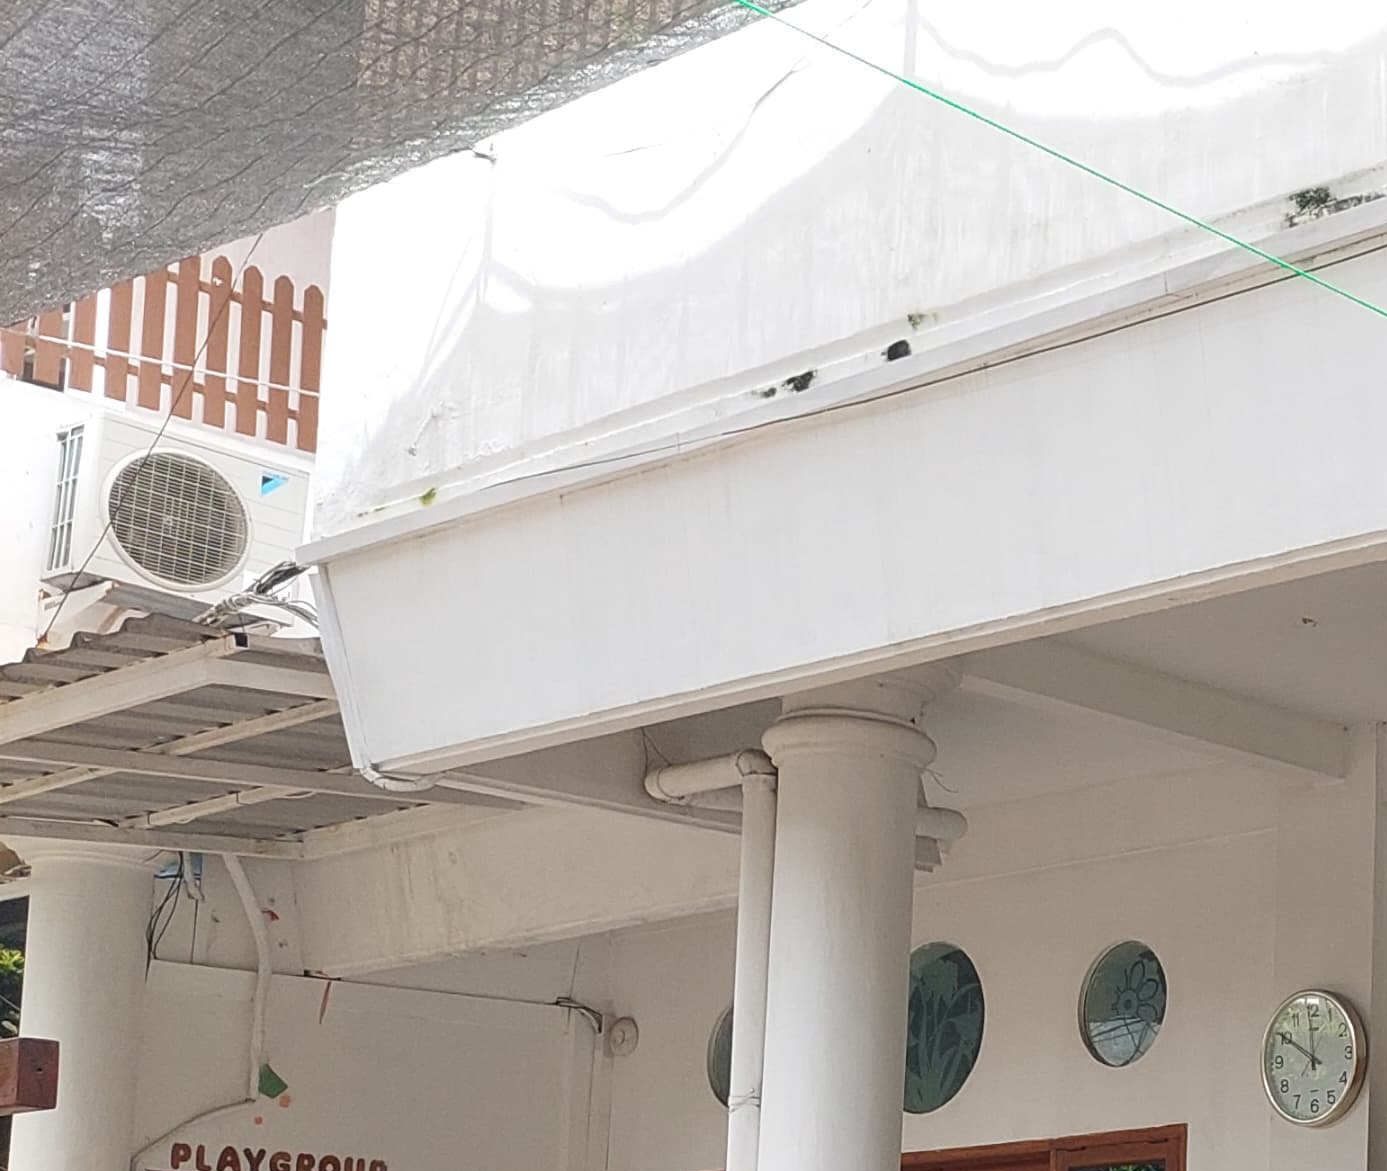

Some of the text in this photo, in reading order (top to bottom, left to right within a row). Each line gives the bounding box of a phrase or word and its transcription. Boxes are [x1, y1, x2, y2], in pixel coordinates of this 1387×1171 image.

[1338, 1022, 1348, 1037] 2
[1344, 1045, 1353, 1060] 3
[1274, 1055, 1284, 1070] 9
[1338, 1071, 1348, 1084] 4
[1280, 1079, 1289, 1093] 8
[1292, 1094, 1301, 1109] 7
[1327, 1089, 1336, 1105] 5
[1310, 1098, 1320, 1113] 6
